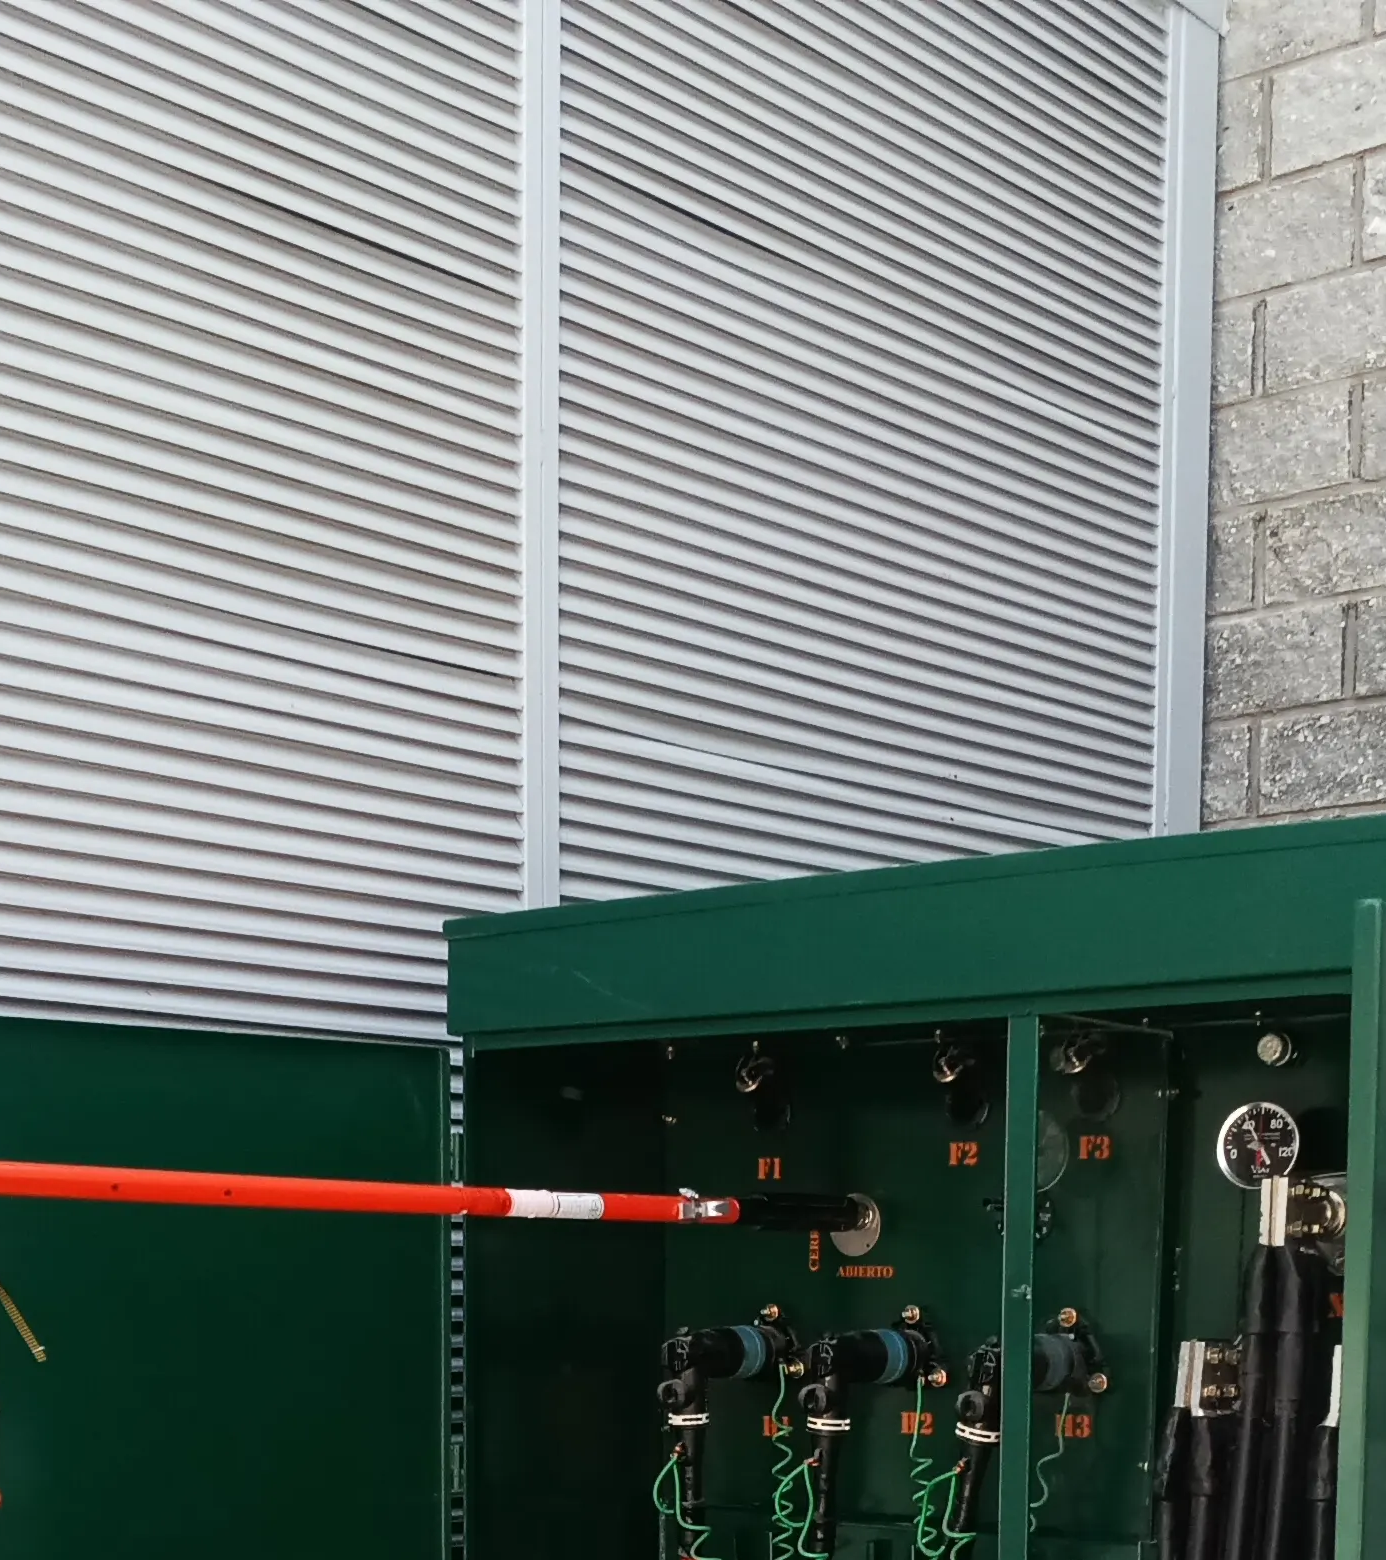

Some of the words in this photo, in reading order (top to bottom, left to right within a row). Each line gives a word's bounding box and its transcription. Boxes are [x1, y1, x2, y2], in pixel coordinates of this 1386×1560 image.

[1270, 1119, 1283, 1129] 80
[949, 1141, 979, 1167] F2
[1078, 1134, 1111, 1160] F3
[757, 1157, 782, 1180] F1
[835, 1265, 894, 1279] ABIERTO
